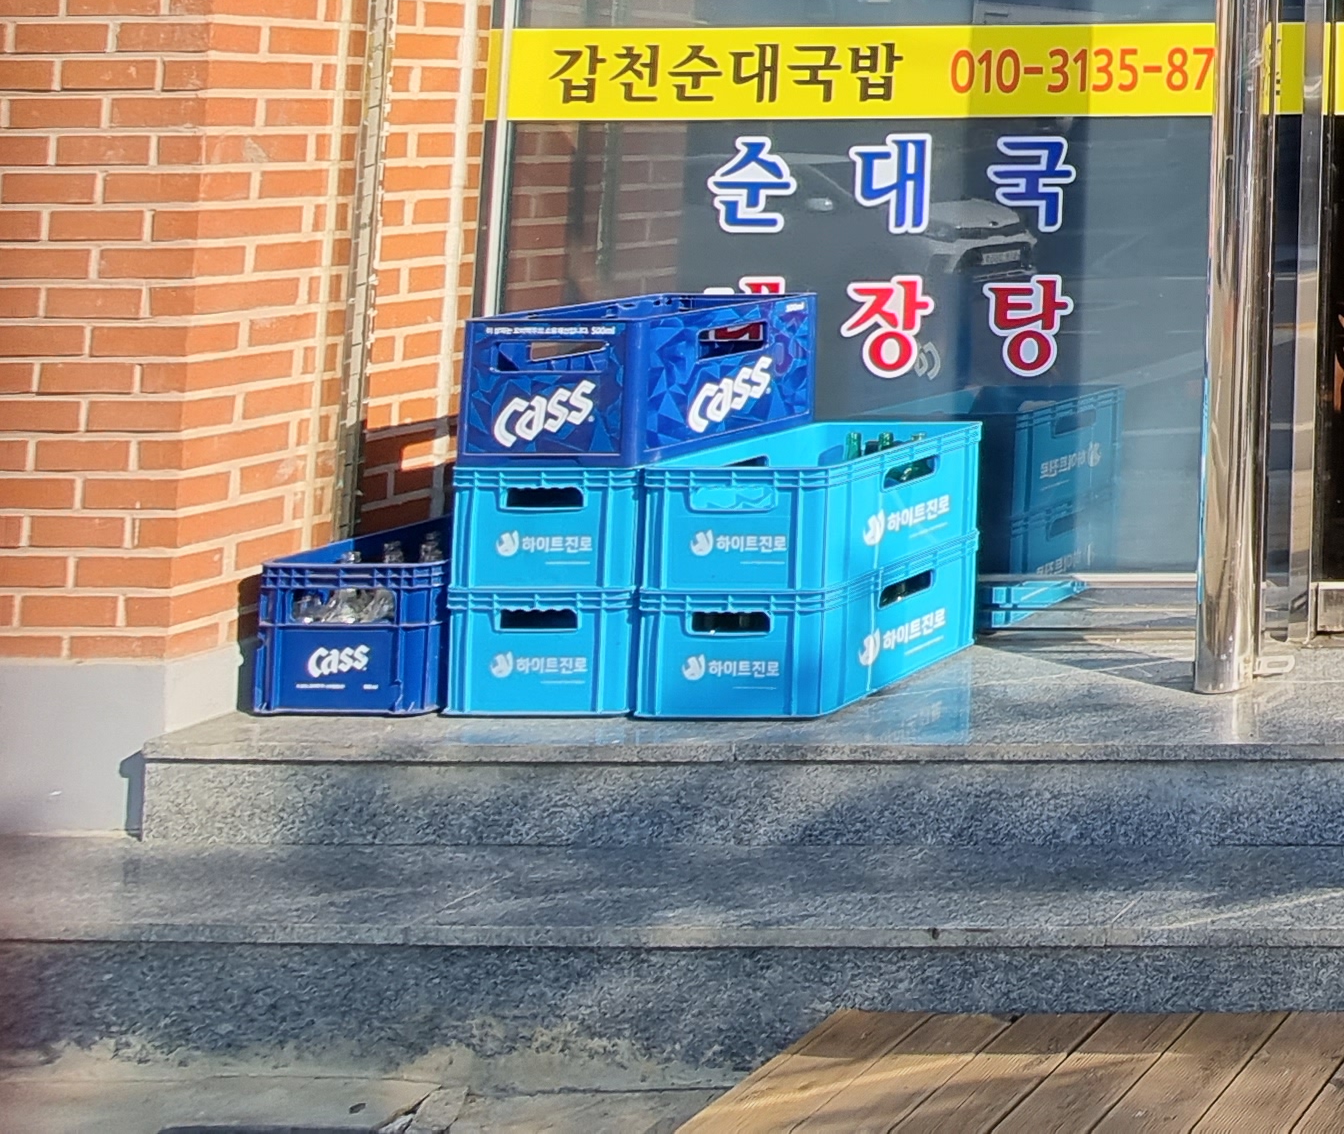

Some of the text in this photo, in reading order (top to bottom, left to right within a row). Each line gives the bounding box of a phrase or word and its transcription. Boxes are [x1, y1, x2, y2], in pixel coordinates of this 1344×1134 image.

[547, 42, 1216, 104] 갑천순대국밥 010-3135-87
[887, 494, 950, 532] 하이트진로
[521, 535, 593, 554] 하이트진로
[716, 534, 788, 553] 하이트진로
[882, 608, 946, 649] 하이트진로
[515, 656, 588, 674] 하이트진로
[707, 660, 780, 678] 하이트진로
